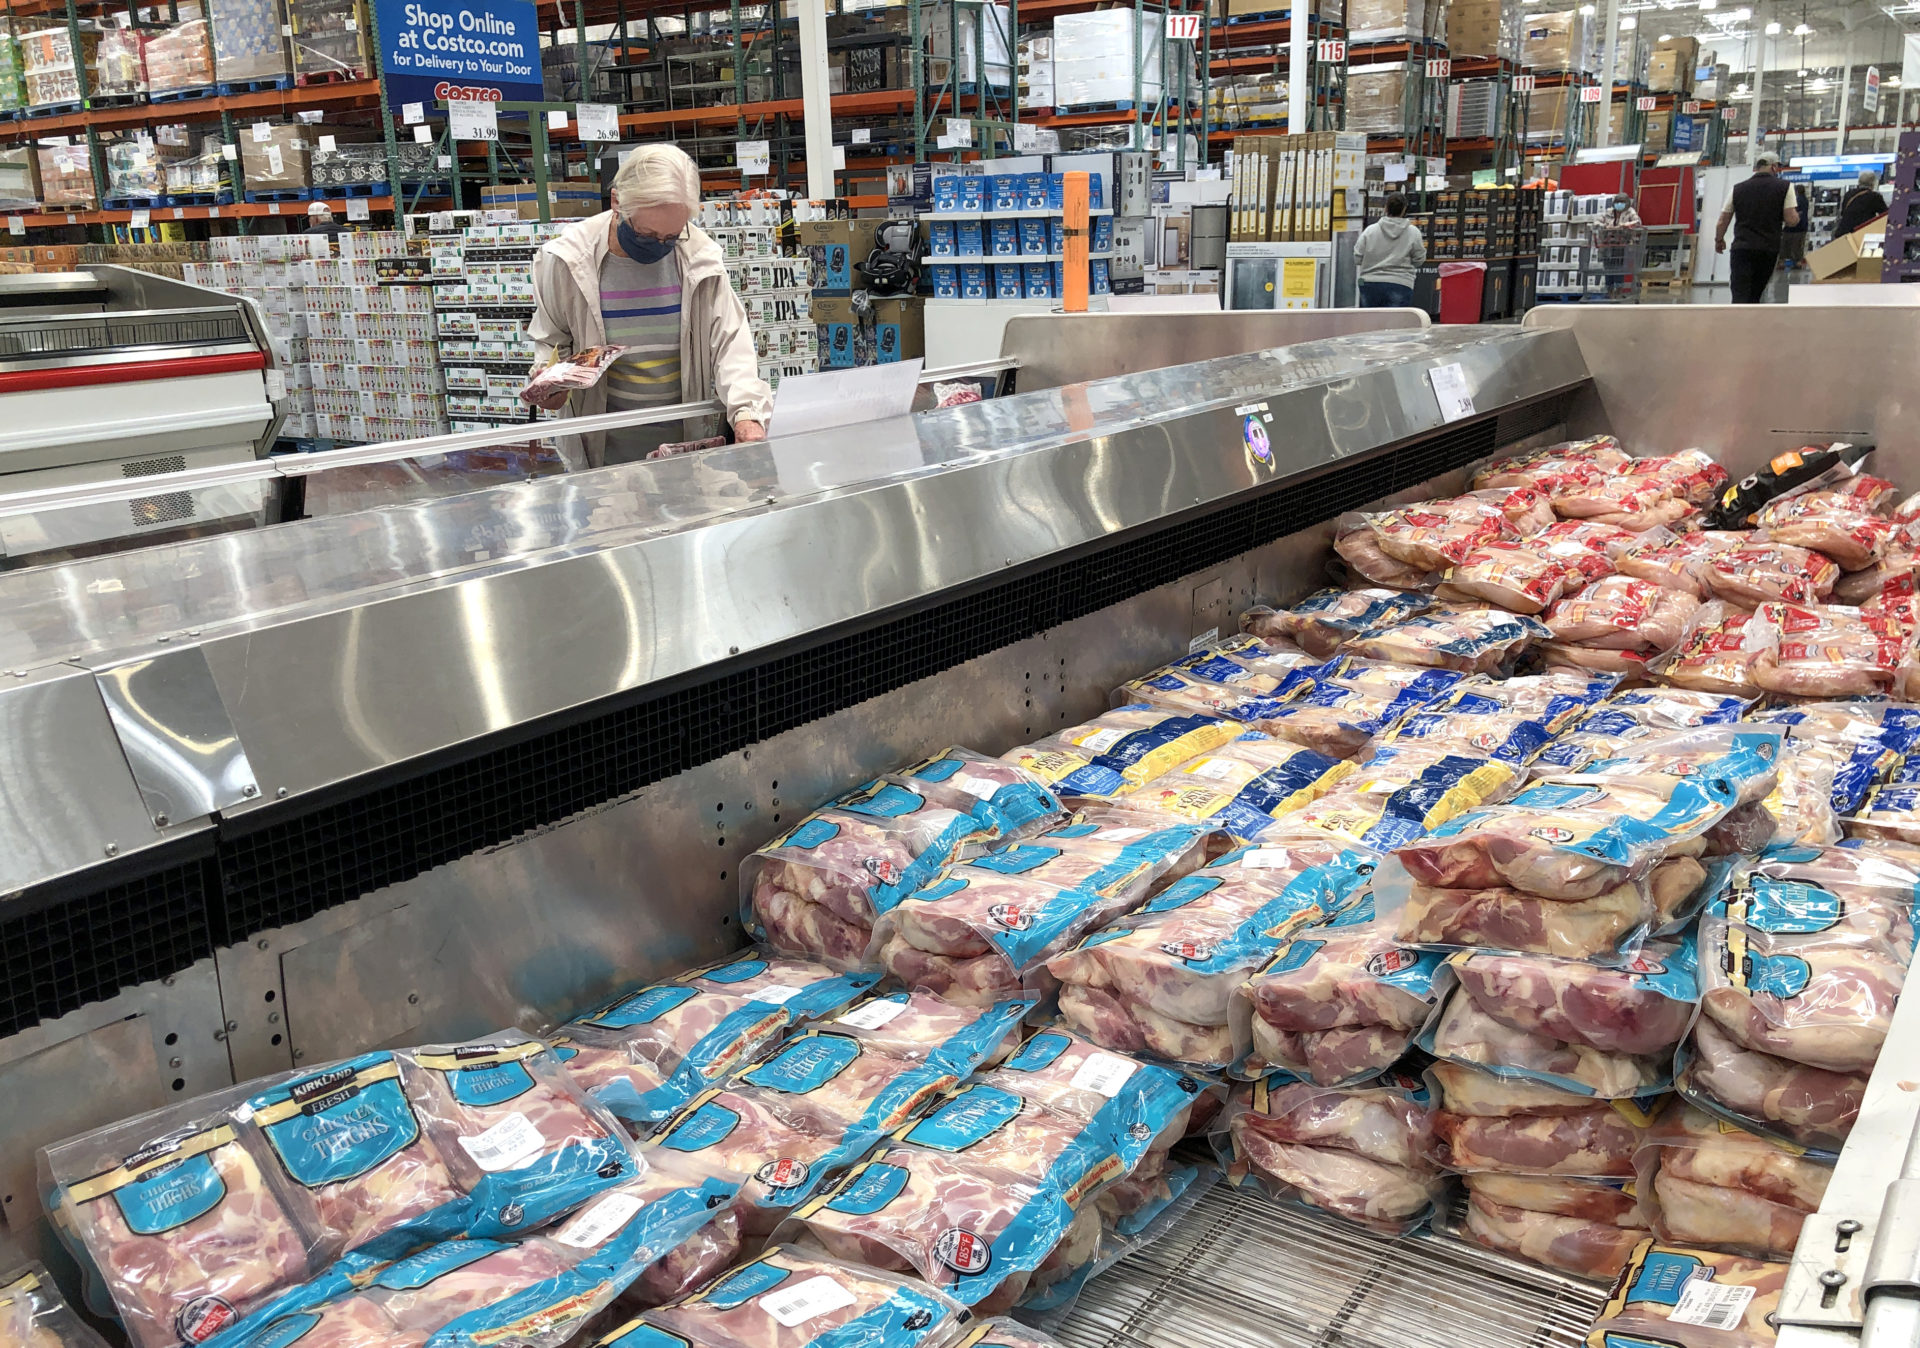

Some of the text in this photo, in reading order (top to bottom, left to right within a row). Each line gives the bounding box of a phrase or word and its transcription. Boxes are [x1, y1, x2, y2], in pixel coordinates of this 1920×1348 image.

[404, 3, 516, 37] Shop Online
[1168, 16, 1198, 38] 117
[398, 29, 525, 58] at Costco.com
[1319, 42, 1344, 61] 115
[392, 51, 532, 76] for Delivery to Your Door
[1428, 60, 1450, 77] 113
[1515, 76, 1534, 91] 111
[1583, 88, 1600, 101] 109
[1638, 97, 1656, 110] 107
[1684, 102, 1699, 113] 105
[1722, 107, 1735, 119] 103
[472, 127, 497, 140] 31.99
[596, 129, 619, 140] 26.99
[753, 157, 769, 167] 9.99
[312, 168, 327, 181] 805
[331, 168, 346, 181] 805
[727, 235, 737, 244] IPA
[757, 233, 767, 242] IPA
[761, 267, 771, 276] IPA
[772, 267, 799, 288] IPA
[763, 301, 773, 310] IPA
[774, 300, 800, 321] IPA
[780, 333, 789, 343] IPA
[293, 1067, 353, 1096] KIRKLAND
[470, 1077, 517, 1094] THIGHS
[311, 1090, 351, 1113] FRESH
[302, 1101, 377, 1142] CHICKEN
[311, 1115, 391, 1160] THIGHS
[144, 1161, 178, 1180] FRESH
[520, 1181, 534, 1191] NO
[147, 1182, 201, 1214] THIGHS
[958, 1236, 972, 1263] 185°F
[1657, 1263, 1682, 1291] THIGHS
